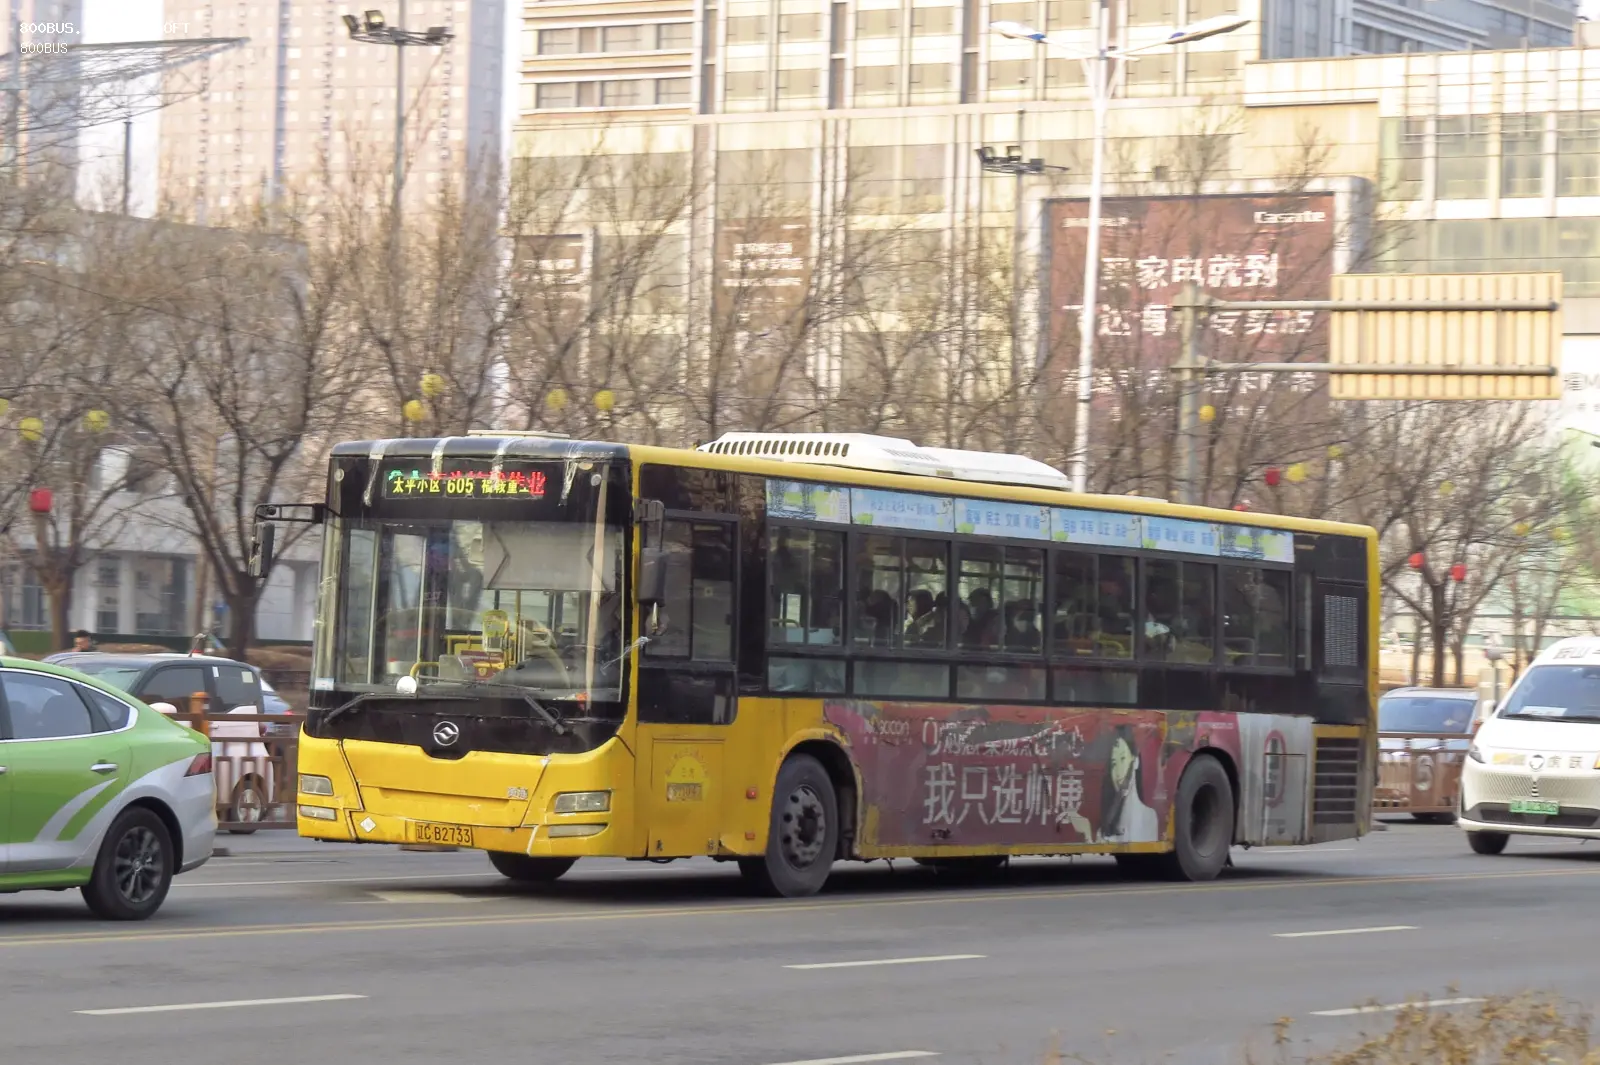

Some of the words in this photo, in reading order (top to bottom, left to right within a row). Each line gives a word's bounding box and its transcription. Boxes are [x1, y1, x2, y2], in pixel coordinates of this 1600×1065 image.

[392, 477, 441, 494] 太平小区
[447, 478, 474, 494] 605
[923, 762, 1085, 825] 我只选帅康
